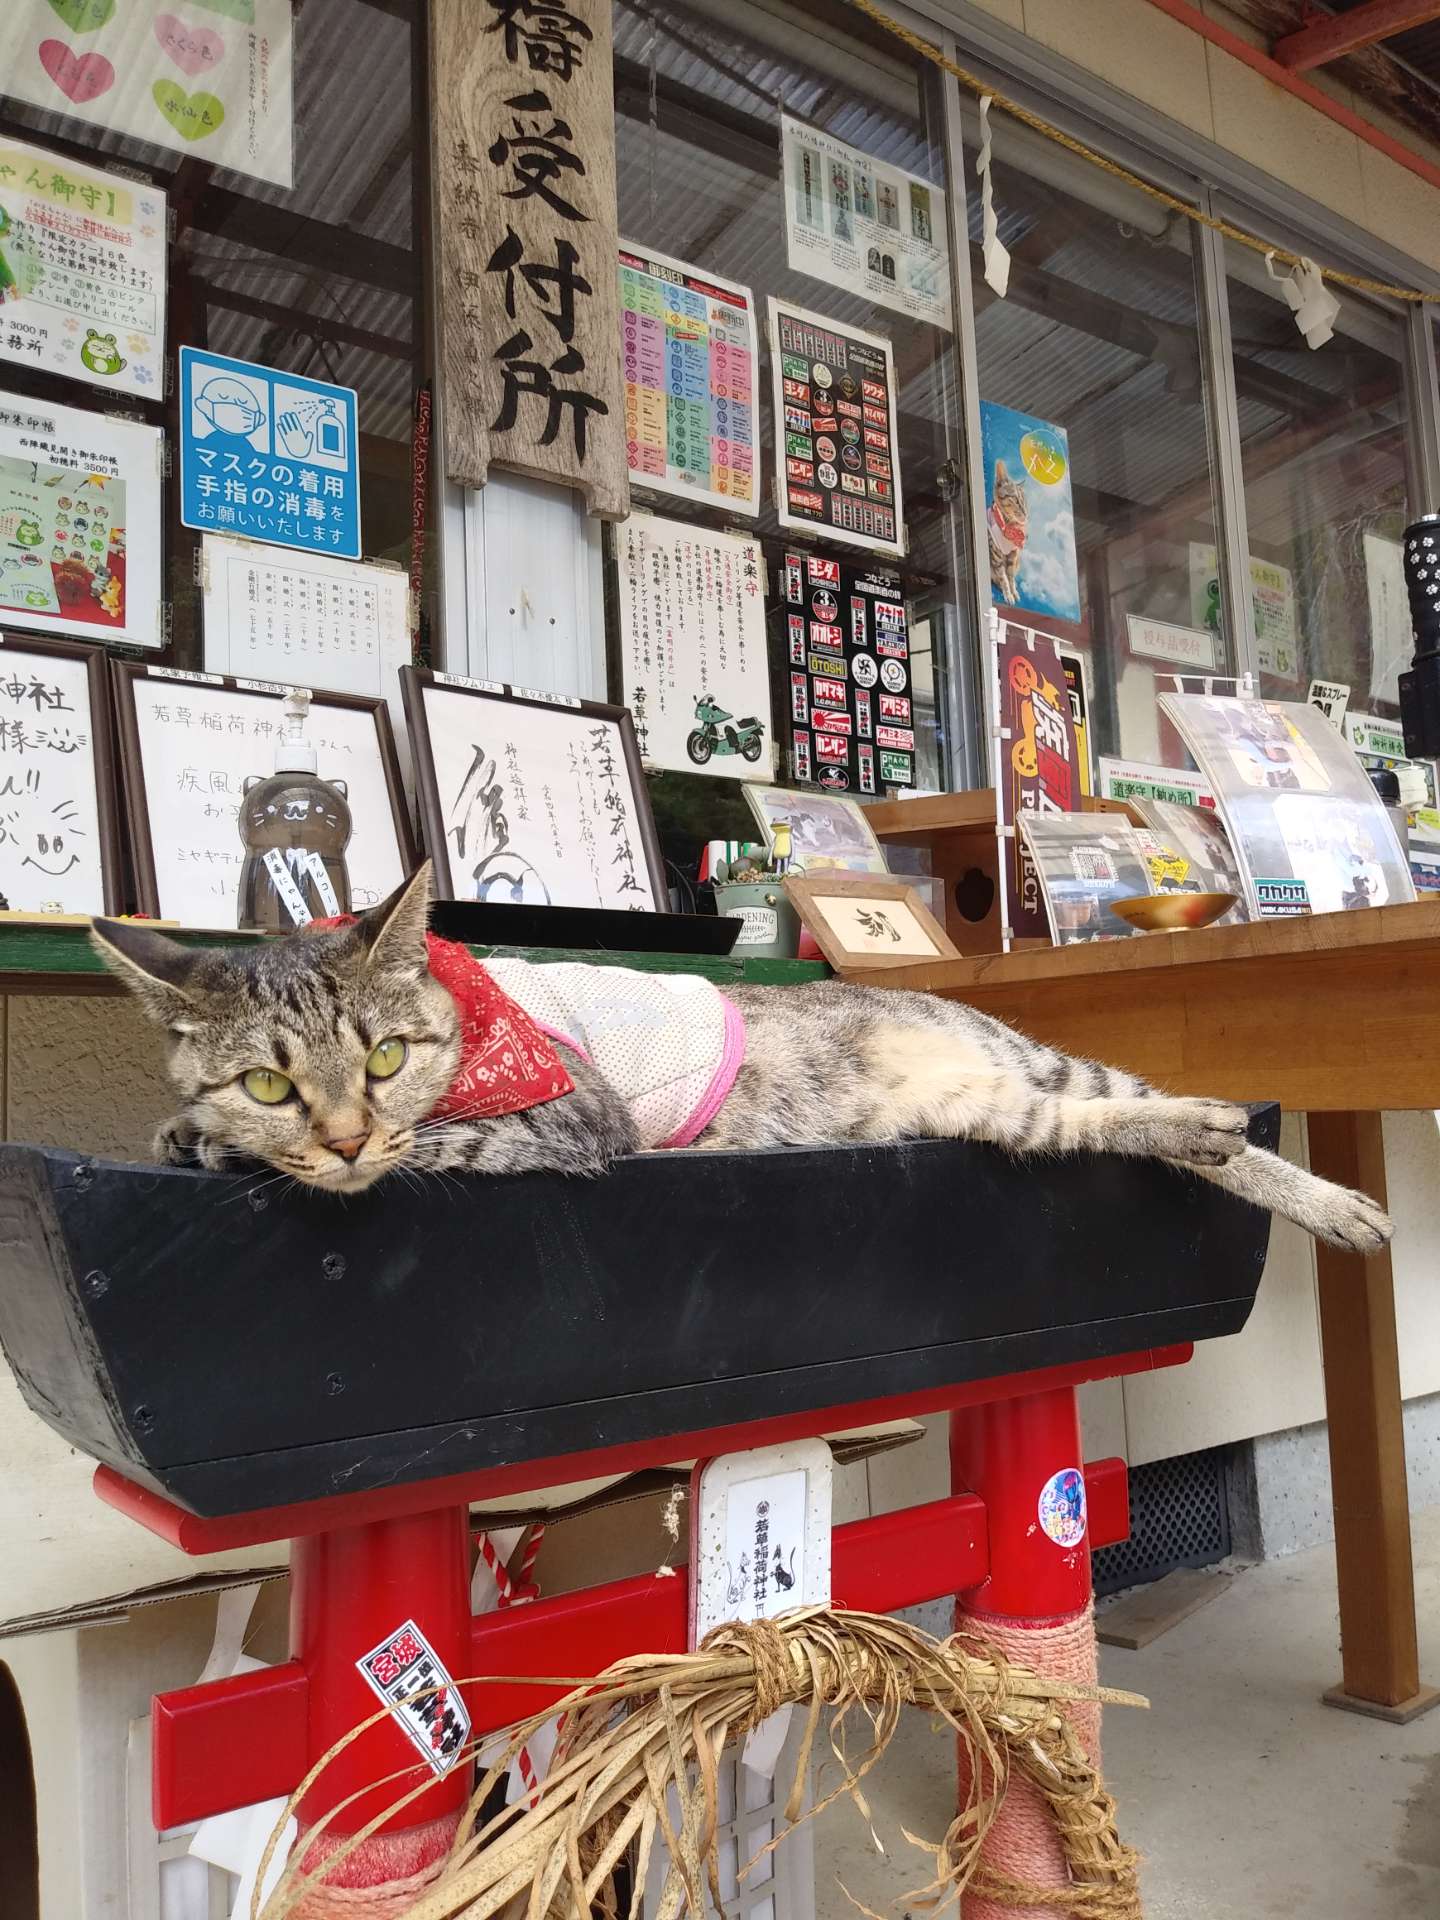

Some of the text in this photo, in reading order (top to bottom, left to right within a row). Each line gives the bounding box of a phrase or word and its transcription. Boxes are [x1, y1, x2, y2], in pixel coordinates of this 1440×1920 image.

[0, 334, 45, 358] 務所
[10, 320, 48, 340] 3000 円
[83, 462, 109, 475] 3500
[110, 467, 120, 477] 円
[194, 447, 344, 500] マスクの着用
[195, 474, 345, 522] 手指の消毒を
[197, 500, 345, 546] お願いいたします
[742, 545, 760, 597] 道楽守
[752, 1519, 770, 1600] 若草稲荷神社
